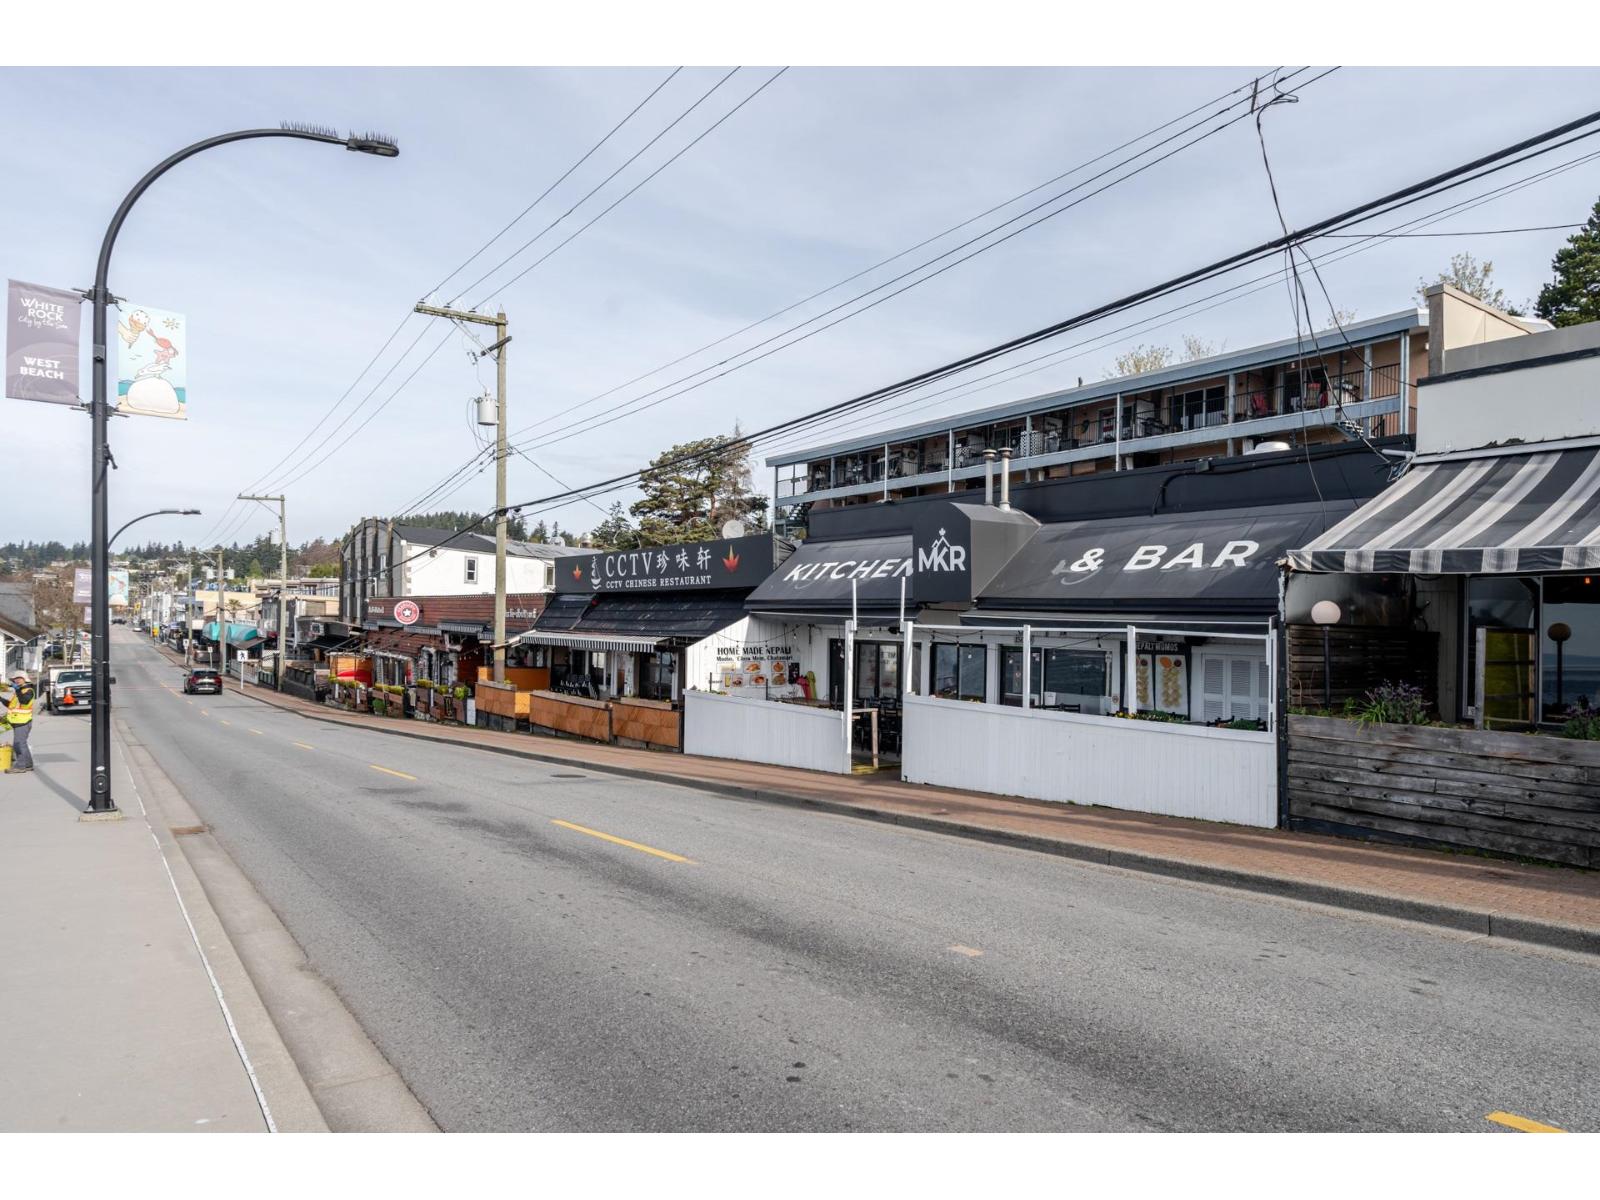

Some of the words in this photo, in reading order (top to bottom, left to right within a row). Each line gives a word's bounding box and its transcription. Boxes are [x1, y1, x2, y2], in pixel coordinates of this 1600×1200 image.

[20, 297, 64, 313] WHITE
[28, 308, 64, 321] ROCK
[23, 356, 61, 368] WEST
[20, 366, 64, 380] BEACH
[605, 551, 653, 577] CCTV
[656, 546, 712, 574] 珍味轩
[918, 545, 966, 572] MKR
[1070, 548, 1105, 572] &
[1122, 540, 1260, 571] BAR
[605, 580, 623, 589] CCTV
[625, 578, 657, 588] CHINESE
[659, 575, 712, 587] RESTAURANT
[717, 647, 741, 655] HOME
[742, 647, 763, 655] MADE
[766, 646, 791, 655] NEPALI
